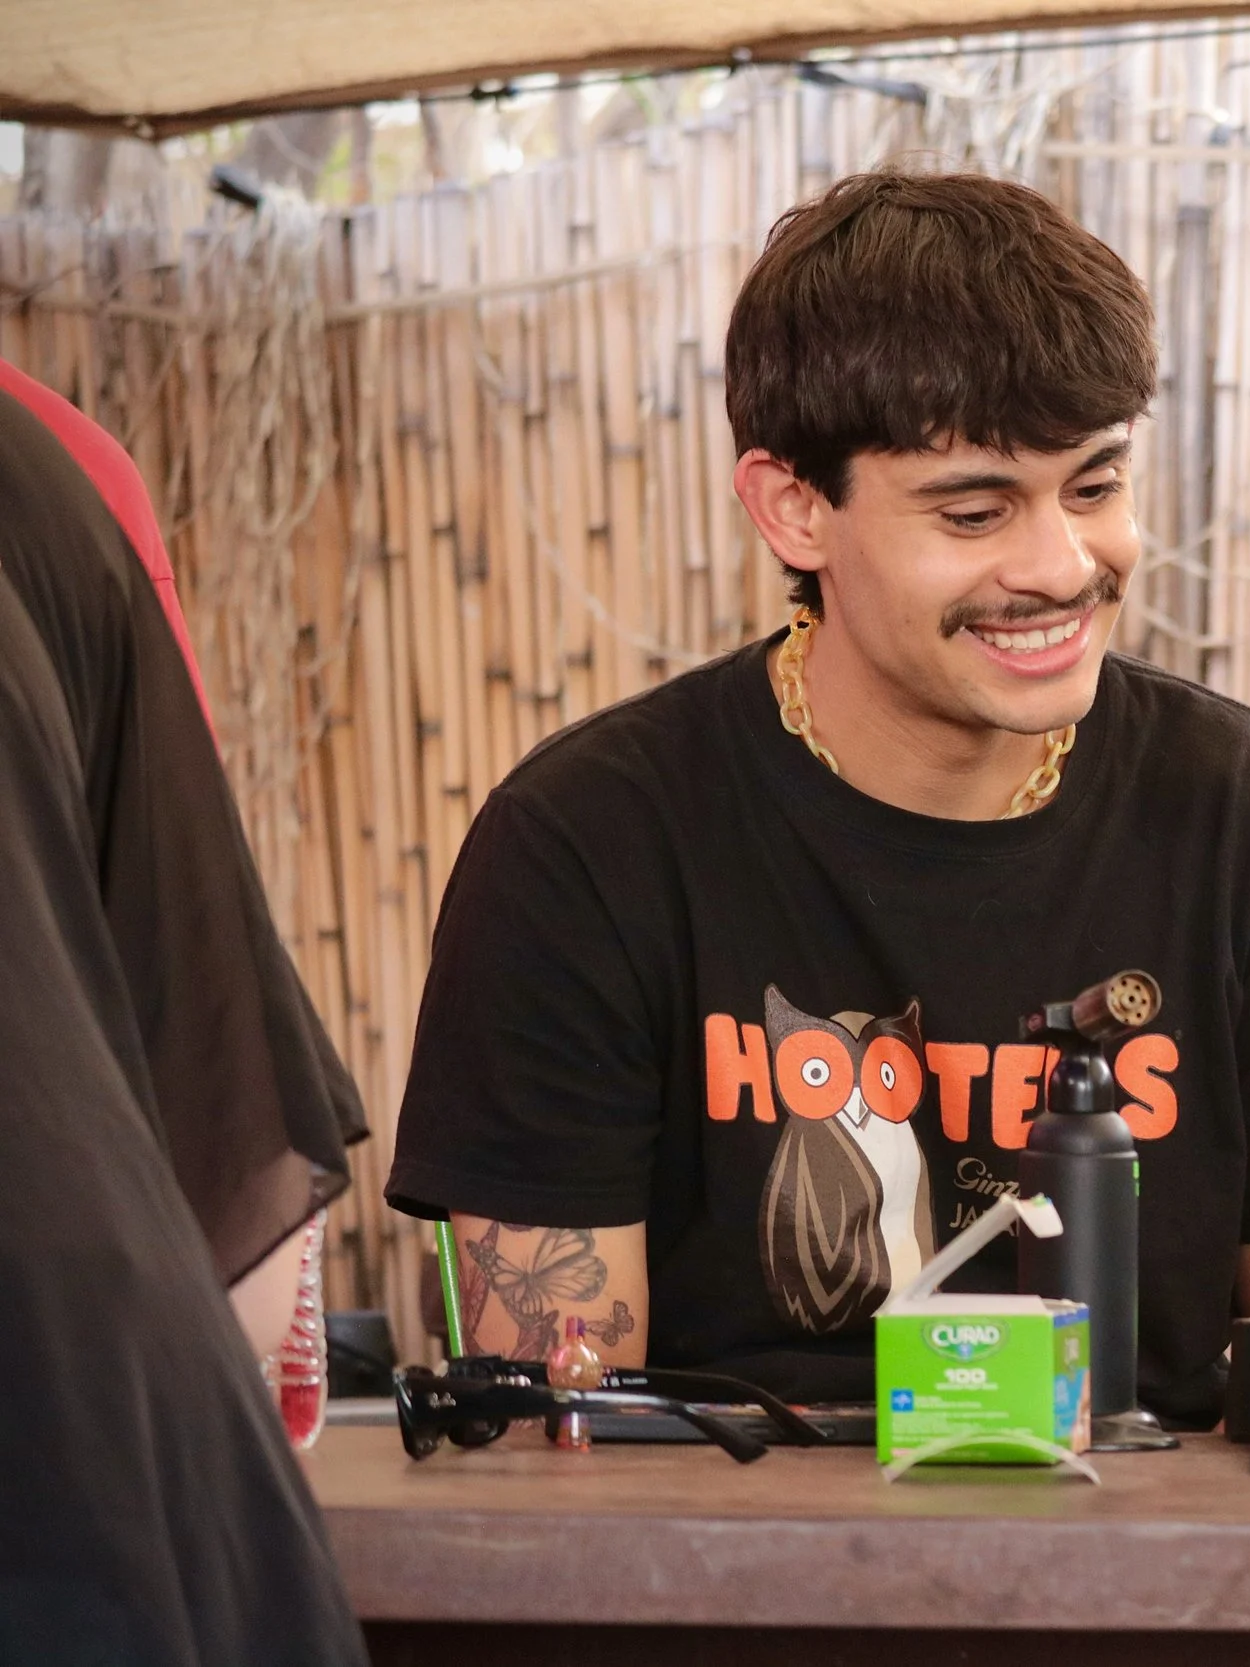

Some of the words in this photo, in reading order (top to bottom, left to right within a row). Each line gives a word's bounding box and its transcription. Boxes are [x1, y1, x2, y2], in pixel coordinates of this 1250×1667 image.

[704, 1012, 1179, 1149] HOOTES
[953, 1157, 1020, 1199] Ginz
[931, 1324, 1000, 1347] CURAD
